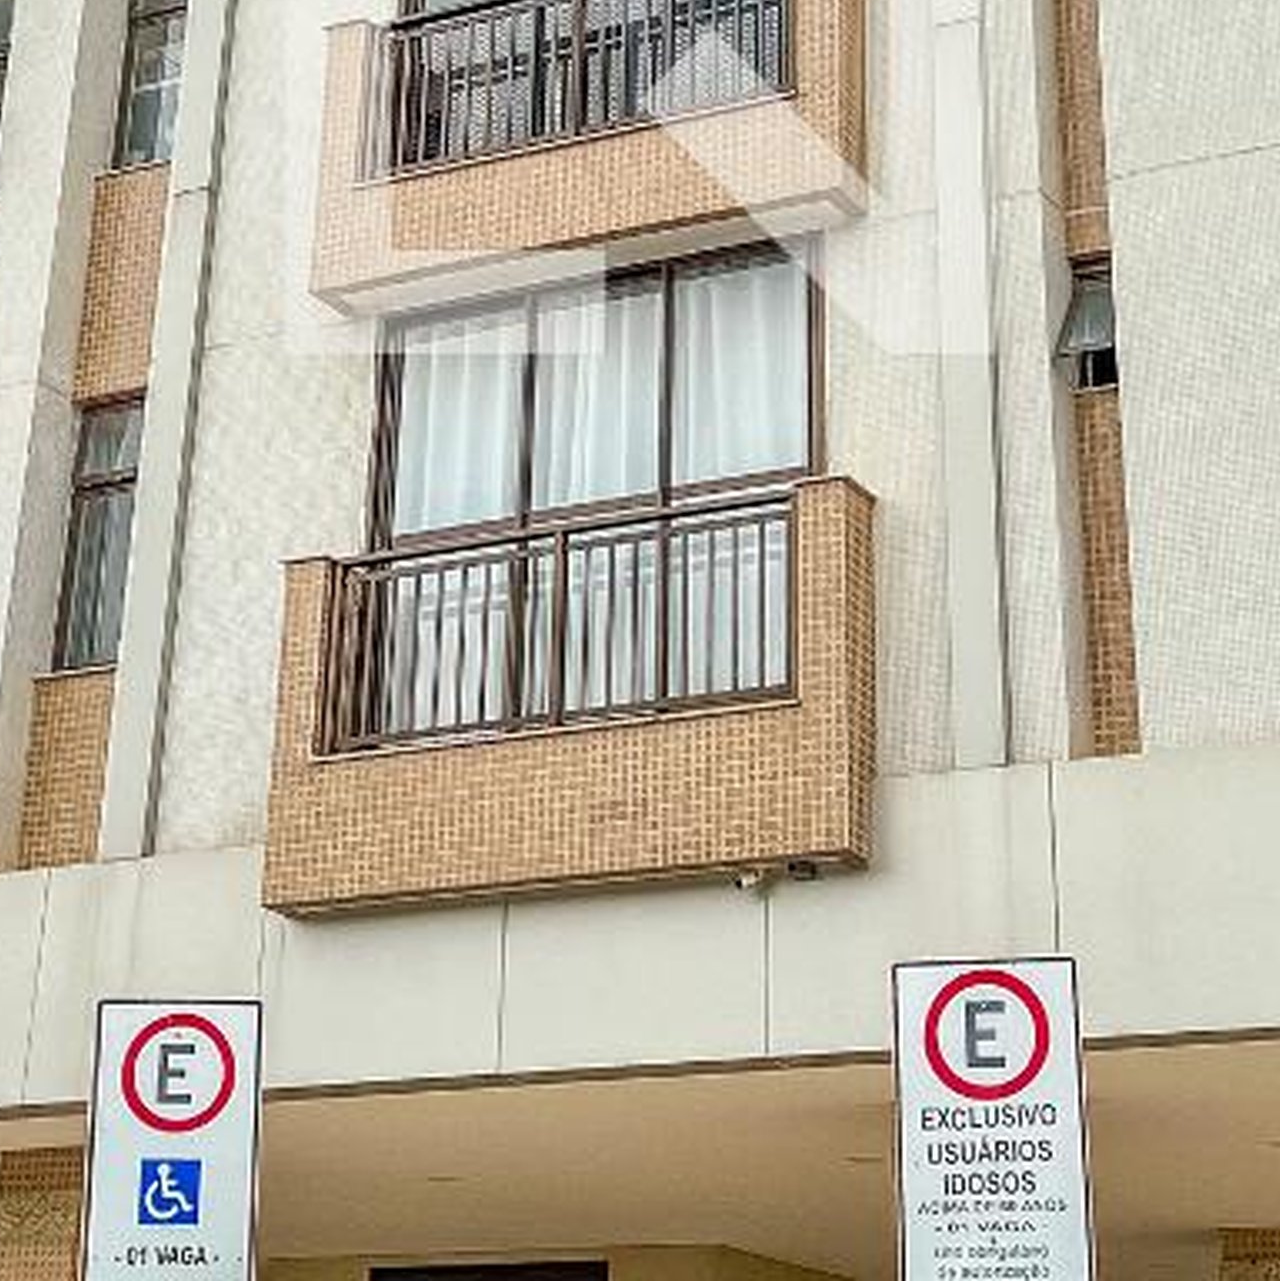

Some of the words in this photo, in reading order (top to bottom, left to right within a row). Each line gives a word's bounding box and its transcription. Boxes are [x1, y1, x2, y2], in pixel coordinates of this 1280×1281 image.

[965, 1000, 1005, 1068] E
[157, 1044, 195, 1104] E
[921, 1103, 1057, 1131] EXCLUSIVO
[927, 1135, 1053, 1165] USUÁRIOS
[944, 1171, 1036, 1195] IDOSOS
[154, 1246, 208, 1265] VAGA
